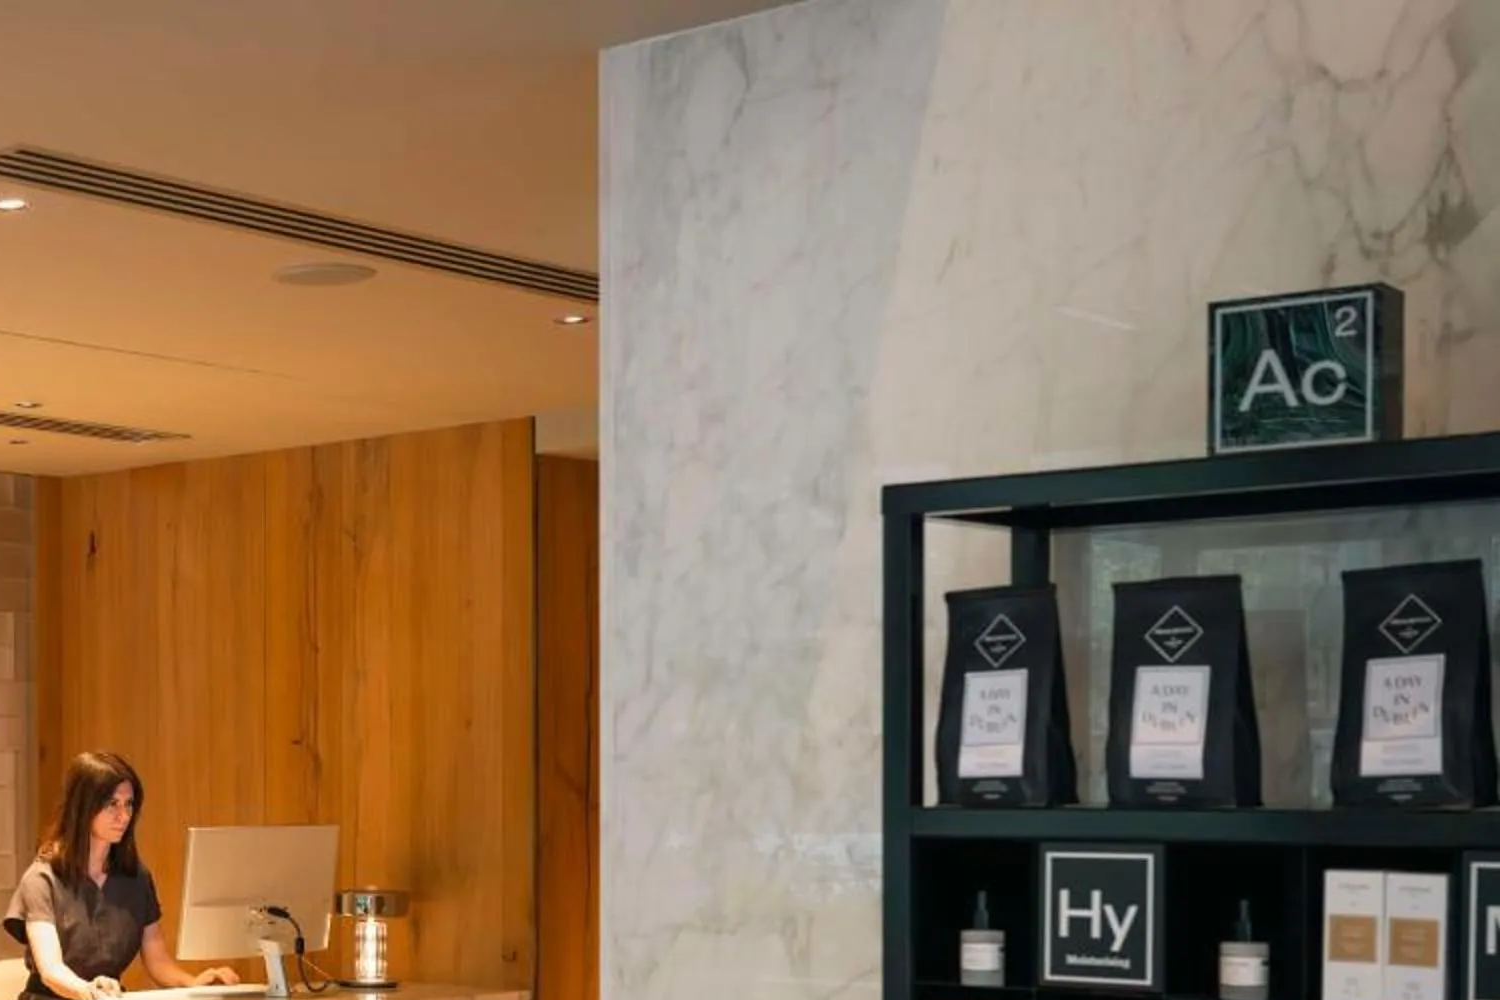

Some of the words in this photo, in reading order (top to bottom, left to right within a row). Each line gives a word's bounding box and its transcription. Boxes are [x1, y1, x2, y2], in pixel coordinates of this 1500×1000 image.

[1334, 305, 1358, 337] 2
[1238, 348, 1348, 412] Ac
[1058, 887, 1139, 952] Hy
